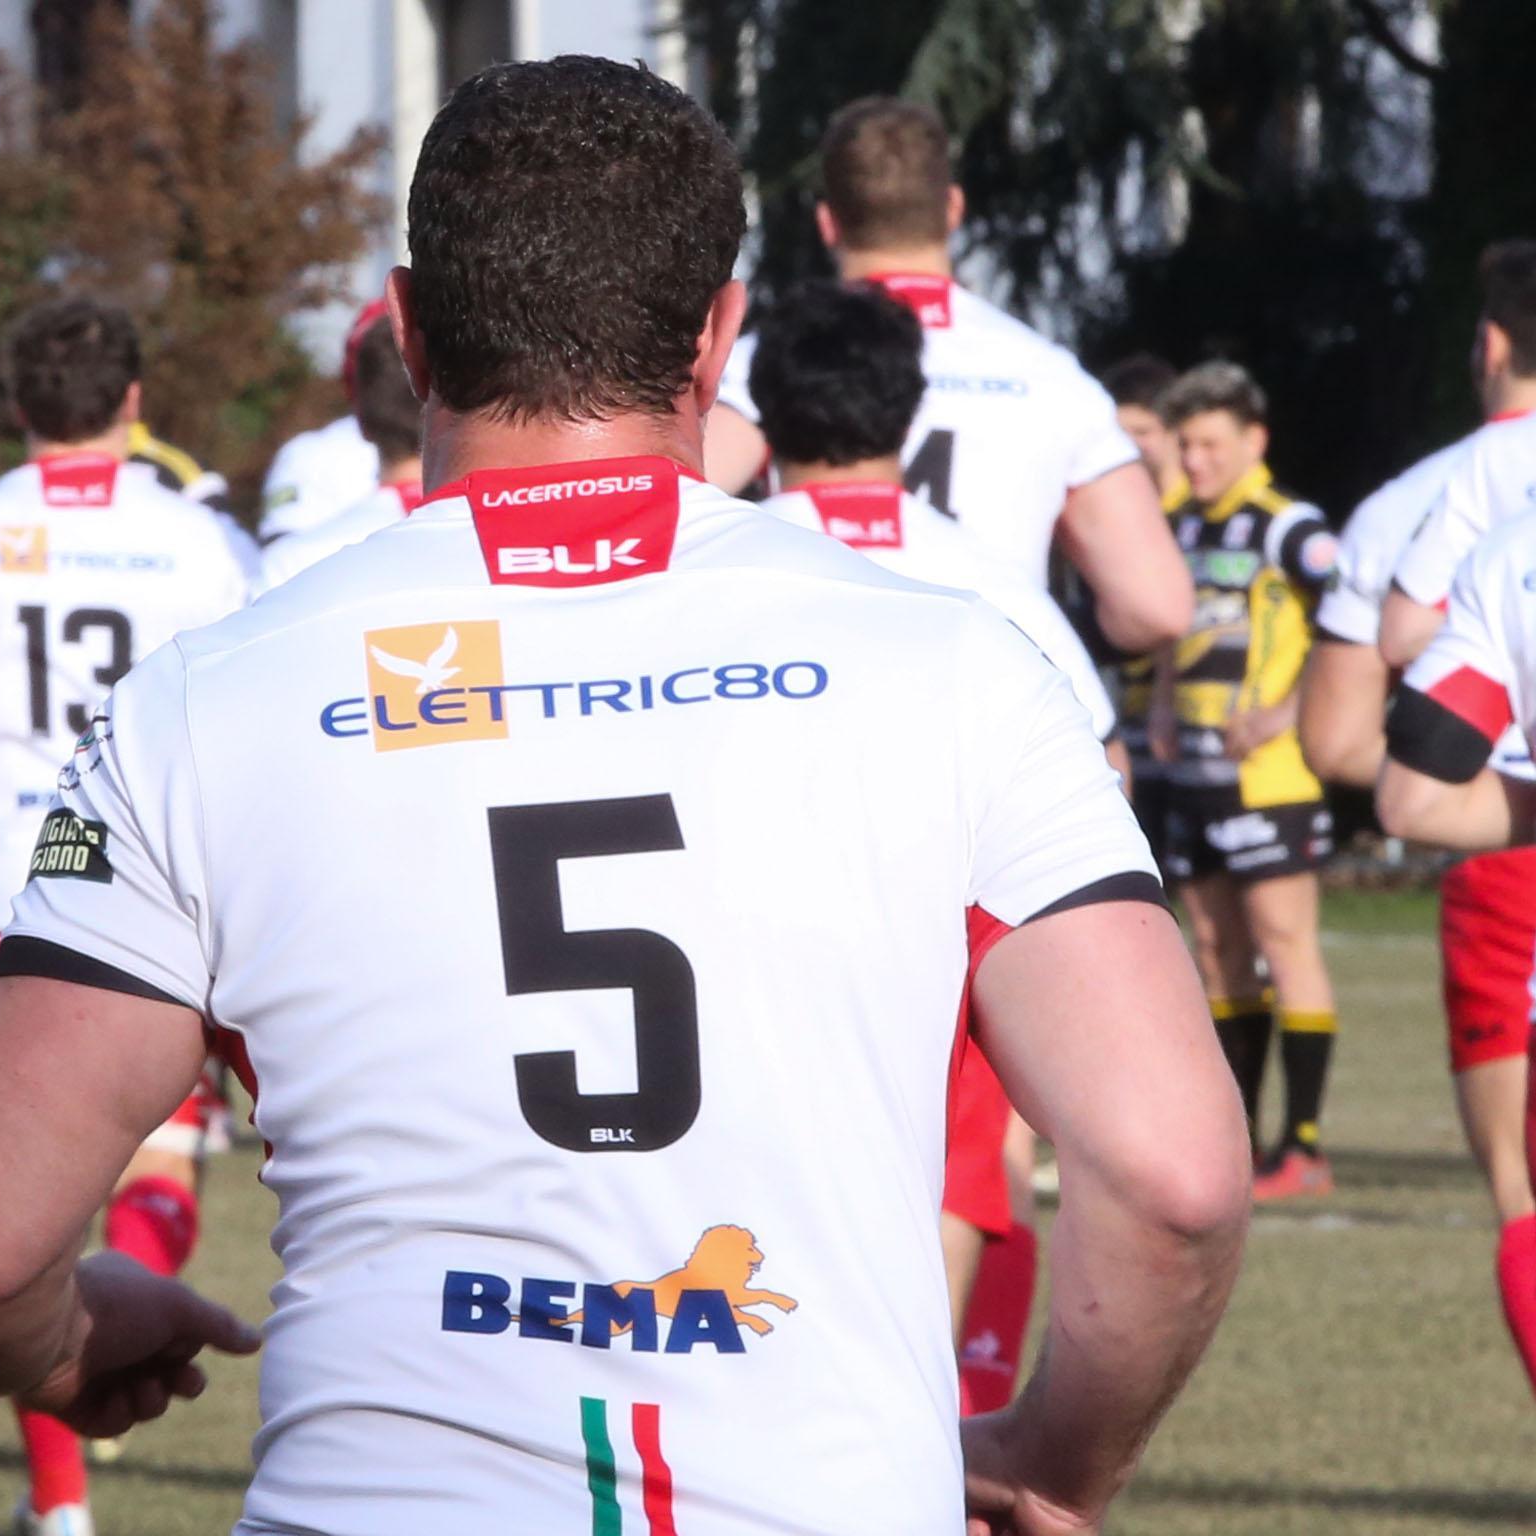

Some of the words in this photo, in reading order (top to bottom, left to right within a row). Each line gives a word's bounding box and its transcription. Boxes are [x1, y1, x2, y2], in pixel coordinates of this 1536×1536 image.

[482, 475, 653, 508] LACERTOSUS
[497, 538, 647, 575] BLK
[17, 604, 132, 737] 13
[319, 660, 830, 738] ELETTRIC80
[486, 792, 702, 1153] 5
[590, 1127, 636, 1143] BLK
[440, 1270, 748, 1355] BEMA
